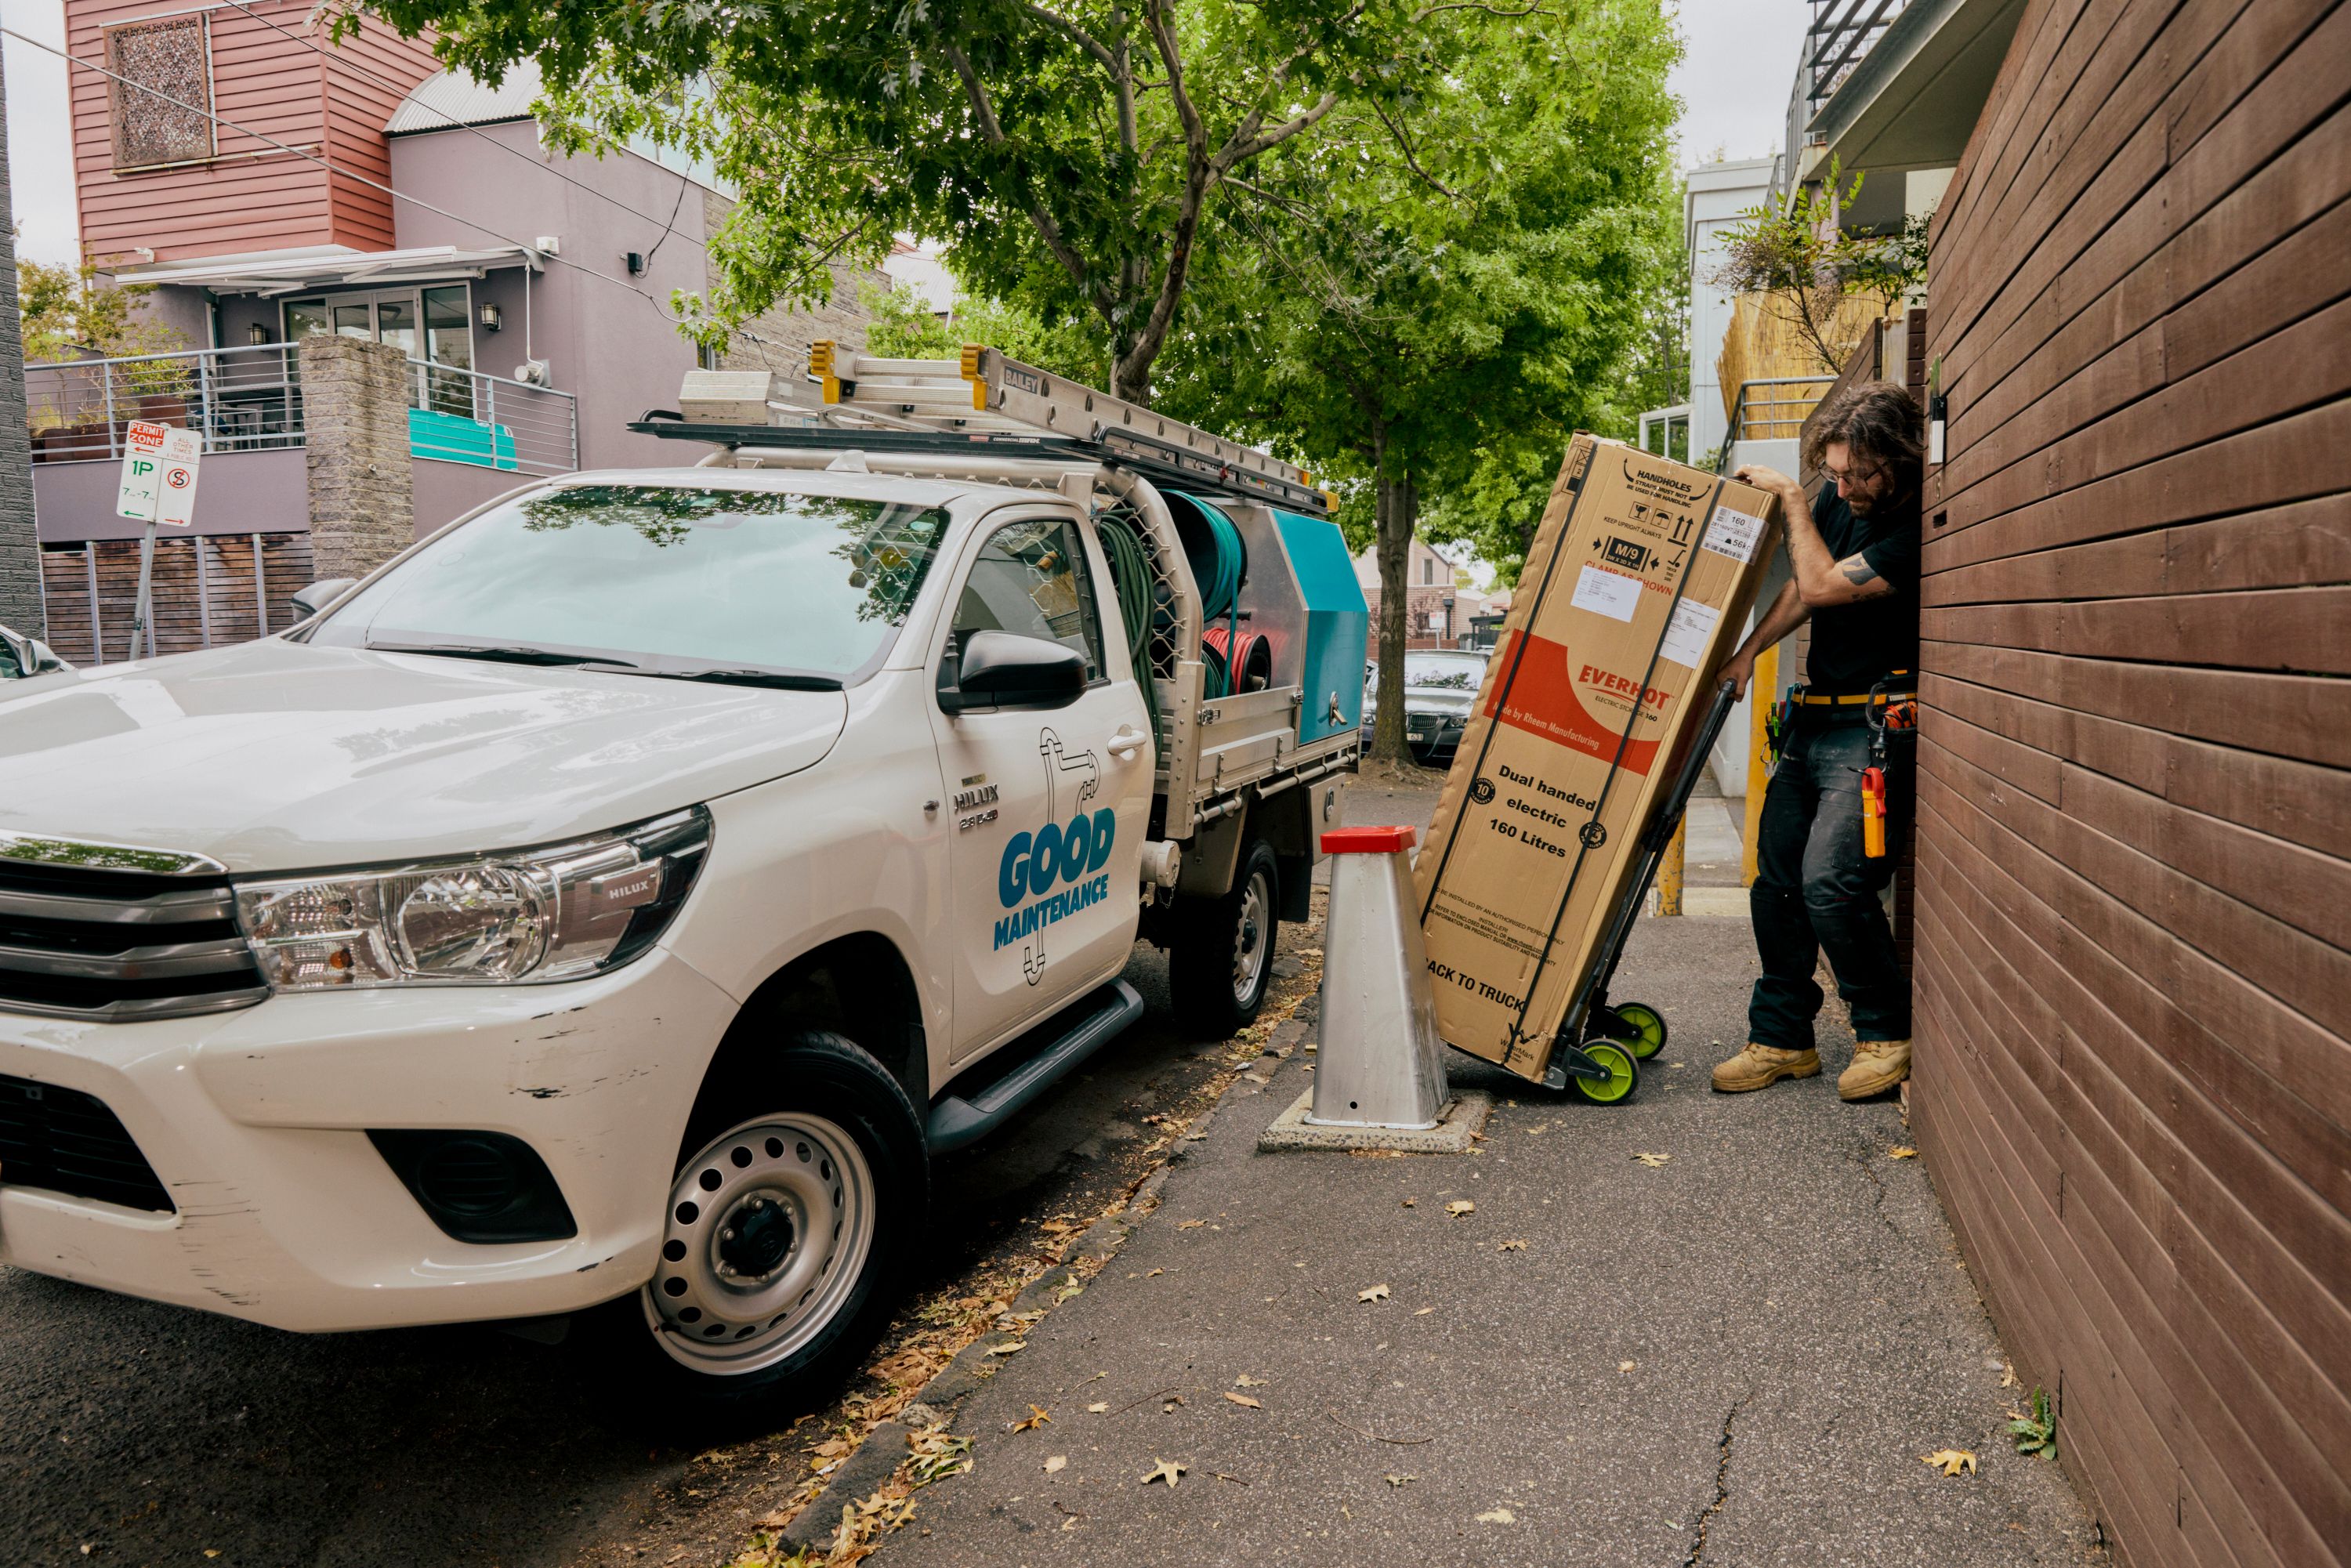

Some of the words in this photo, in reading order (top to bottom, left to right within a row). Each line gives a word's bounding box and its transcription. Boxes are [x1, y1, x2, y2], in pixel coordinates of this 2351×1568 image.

[1005, 368, 1038, 393] BAILEY
[130, 433, 163, 447] ZONE
[131, 424, 164, 436] PERMIT
[132, 460, 154, 476] 1P
[1635, 480, 1657, 491] STRAPS
[1657, 487, 1675, 496] MUST
[1637, 469, 1692, 493] HANDHOLES
[1635, 486, 1650, 495] USED
[1650, 491, 1661, 499] FOR
[1662, 495, 1692, 508] HANDLING
[1603, 516, 1617, 524] KEEP
[1617, 520, 1642, 533] UPRIGHT
[1640, 527, 1662, 539] ALWAYS
[1731, 516, 1745, 526] 160
[1615, 543, 1639, 560] M/9
[1733, 539, 1751, 552] 56kg
[1578, 664, 1669, 711] EVERHOT
[1595, 695, 1619, 708] ELECTRIC
[1619, 704, 1643, 717] STORGE
[1646, 713, 1657, 722] 160
[1492, 701, 1512, 716] Mde
[1512, 707, 1523, 721] by
[1523, 712, 1548, 730] Rheem
[1548, 722, 1599, 751] Manufacturing
[953, 784, 999, 813] HILUX
[1477, 784, 1490, 796] 10
[1498, 765, 1534, 788] Dual
[1537, 780, 1597, 812] handed
[1507, 798, 1567, 828] electric
[1491, 818, 1517, 838] 160
[1520, 831, 1567, 857] Litres
[998, 807, 1116, 909] GOOD
[610, 880, 649, 900] HILUX
[994, 873, 1109, 951] MAINTENANCE
[1435, 904, 1450, 914] REFER
[1456, 913, 1480, 927] ENCLOSED
[1480, 924, 1498, 936] MANUAL
[1448, 892, 1476, 908] INSTALLED
[1491, 911, 1527, 930] AUTHORISED
[1527, 925, 1549, 940] PERSON
[1552, 937, 1565, 946] NLY
[1434, 910, 1464, 928] INFORMATION
[1471, 927, 1494, 940] PRODUCT
[1493, 936, 1521, 952] SUITABILITY
[1530, 951, 1557, 967] WARANTY
[1426, 958, 1456, 982] ACK
[1458, 972, 1476, 990] TO
[1478, 982, 1525, 1013] TRUCK
[1500, 1038, 1534, 1061] WaerMark
